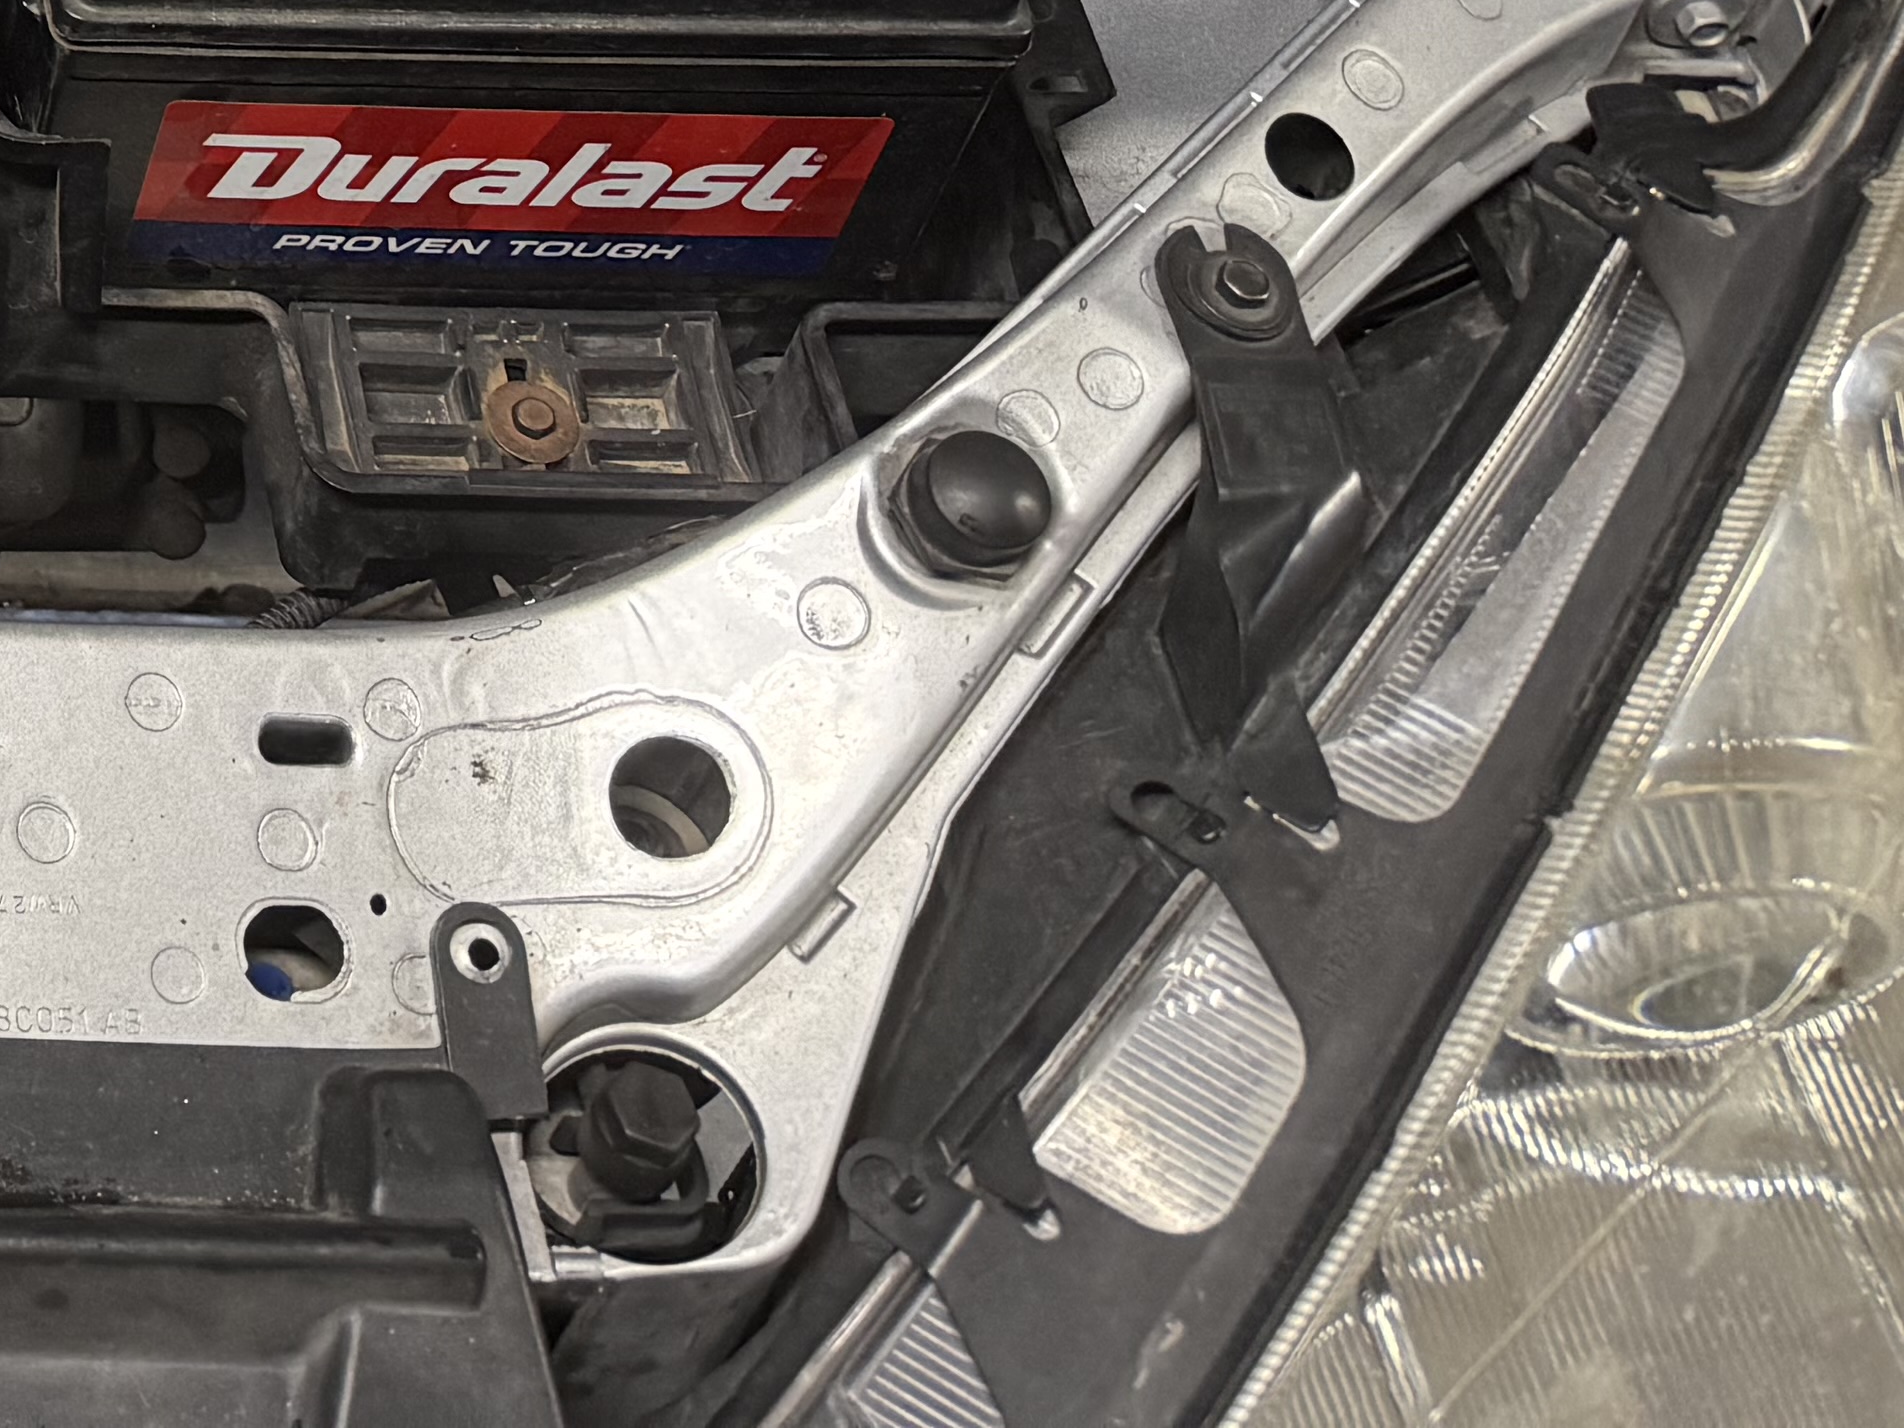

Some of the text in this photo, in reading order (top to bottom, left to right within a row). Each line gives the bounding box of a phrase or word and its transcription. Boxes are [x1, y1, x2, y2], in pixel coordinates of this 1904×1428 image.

[202, 133, 829, 213] Duralast
[271, 233, 685, 261] PROVEN TOUGH
